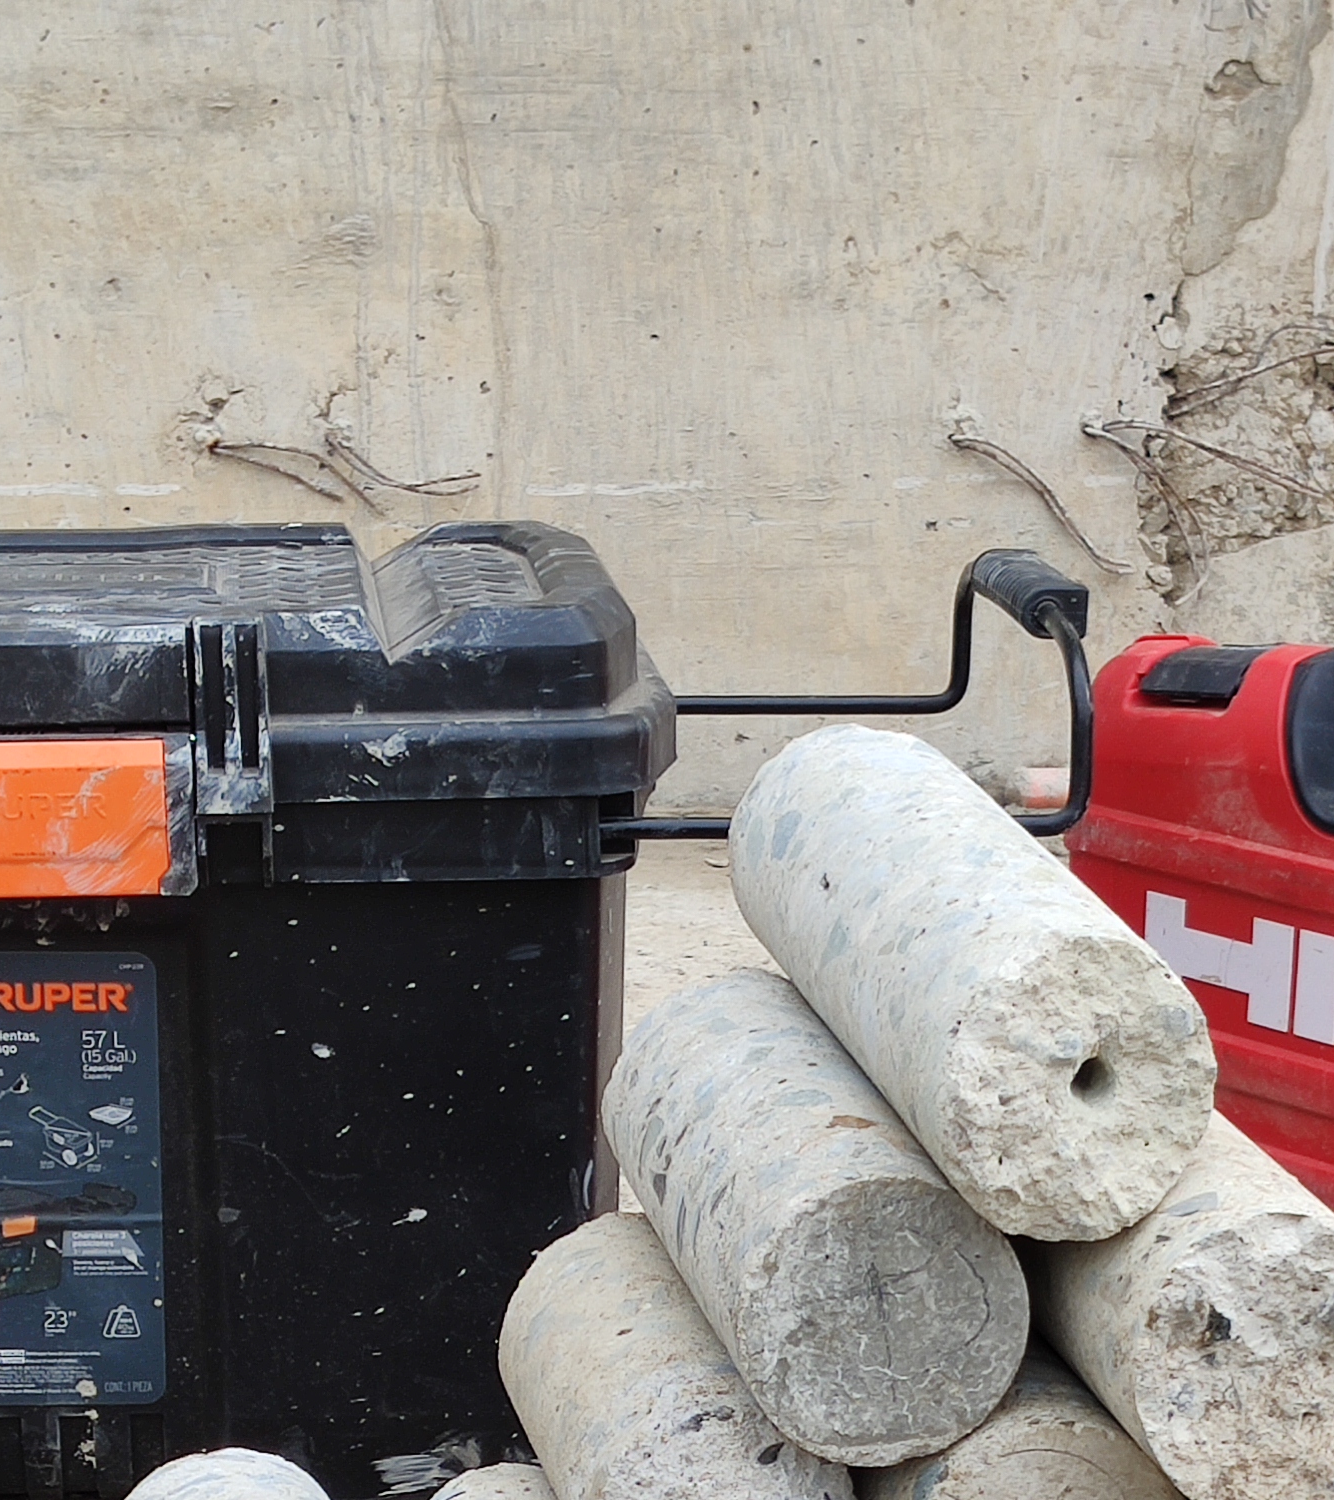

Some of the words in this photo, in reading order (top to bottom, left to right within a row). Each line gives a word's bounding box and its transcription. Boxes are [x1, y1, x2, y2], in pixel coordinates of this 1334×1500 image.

[81, 1030, 108, 1049] 57
[113, 1030, 126, 1049] L
[81, 1049, 103, 1064] (15
[104, 1049, 137, 1065] Gal.)
